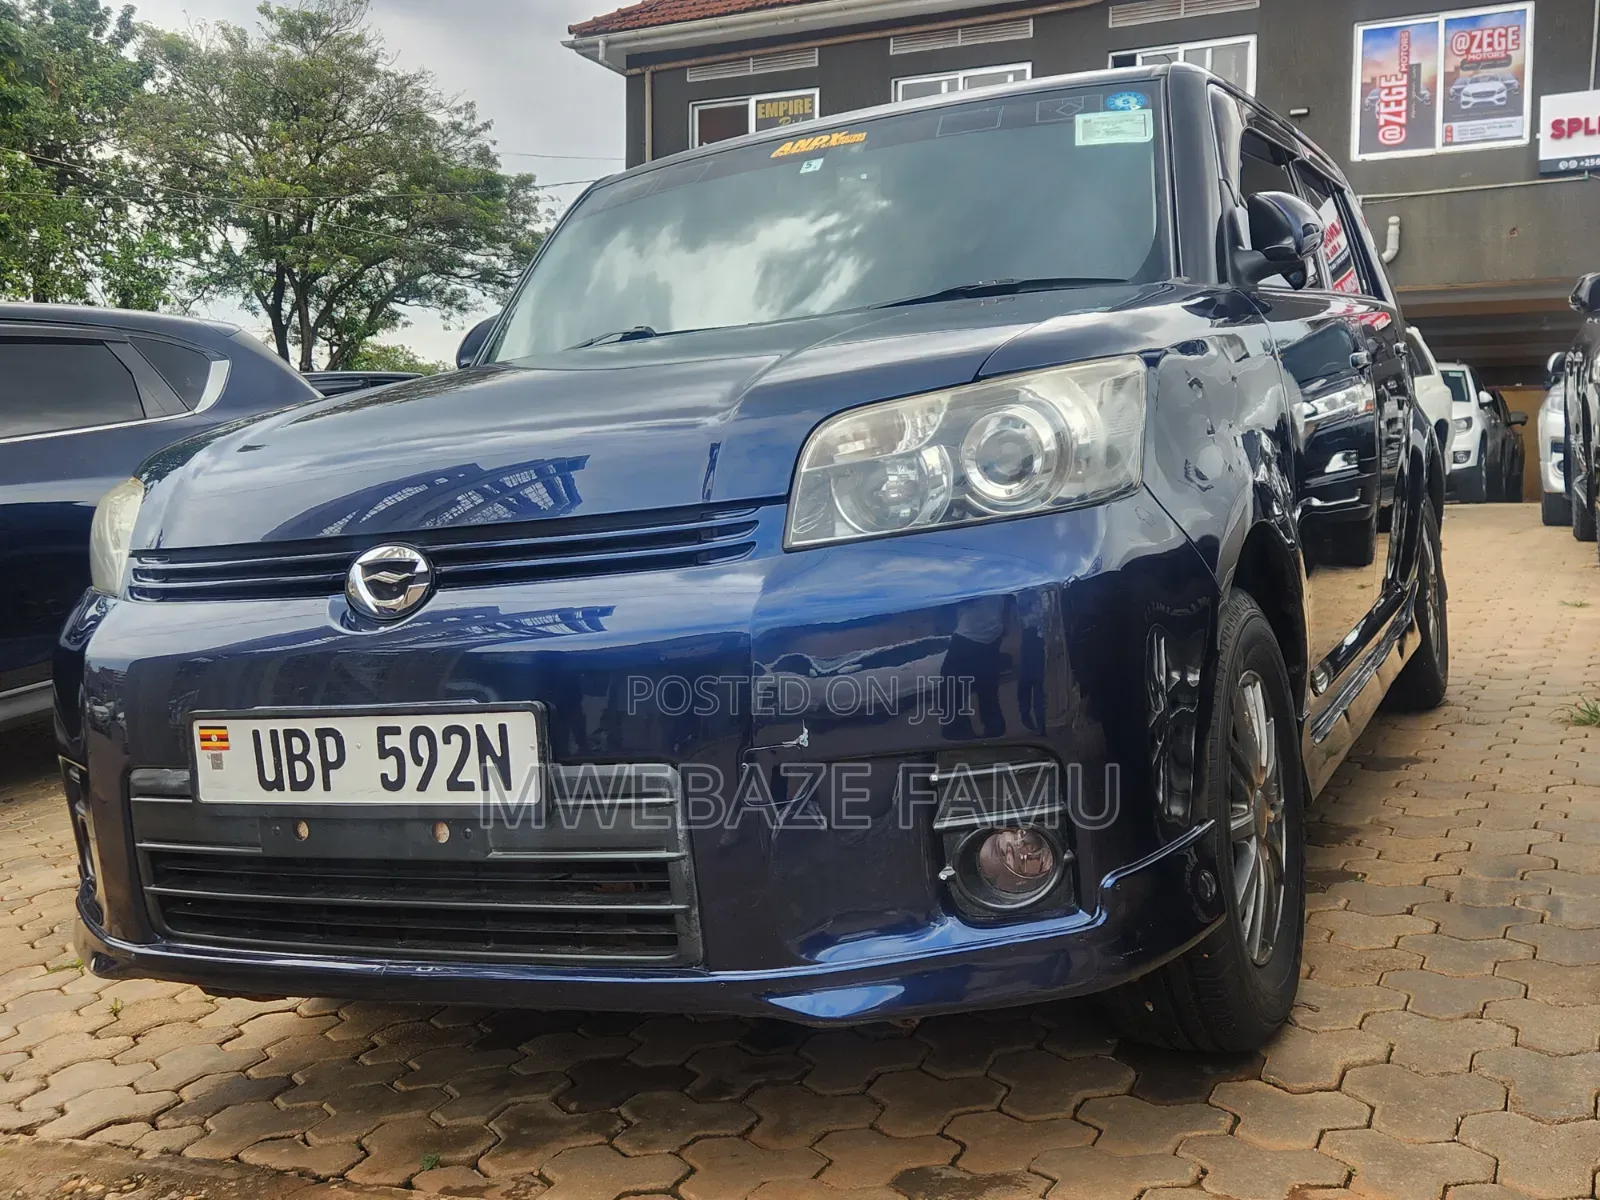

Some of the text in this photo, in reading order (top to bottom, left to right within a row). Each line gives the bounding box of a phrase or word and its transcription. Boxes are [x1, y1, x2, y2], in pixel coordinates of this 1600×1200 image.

[1401, 31, 1410, 71] MOTORS
[1452, 26, 1521, 56] @ZEGE
[1467, 51, 1506, 60] MOTORS
[757, 97, 813, 119] EMPIRE
[1379, 73, 1408, 145] @ZEGE
[1550, 115, 1600, 140] SPL
[252, 723, 512, 792] UBP 592N
